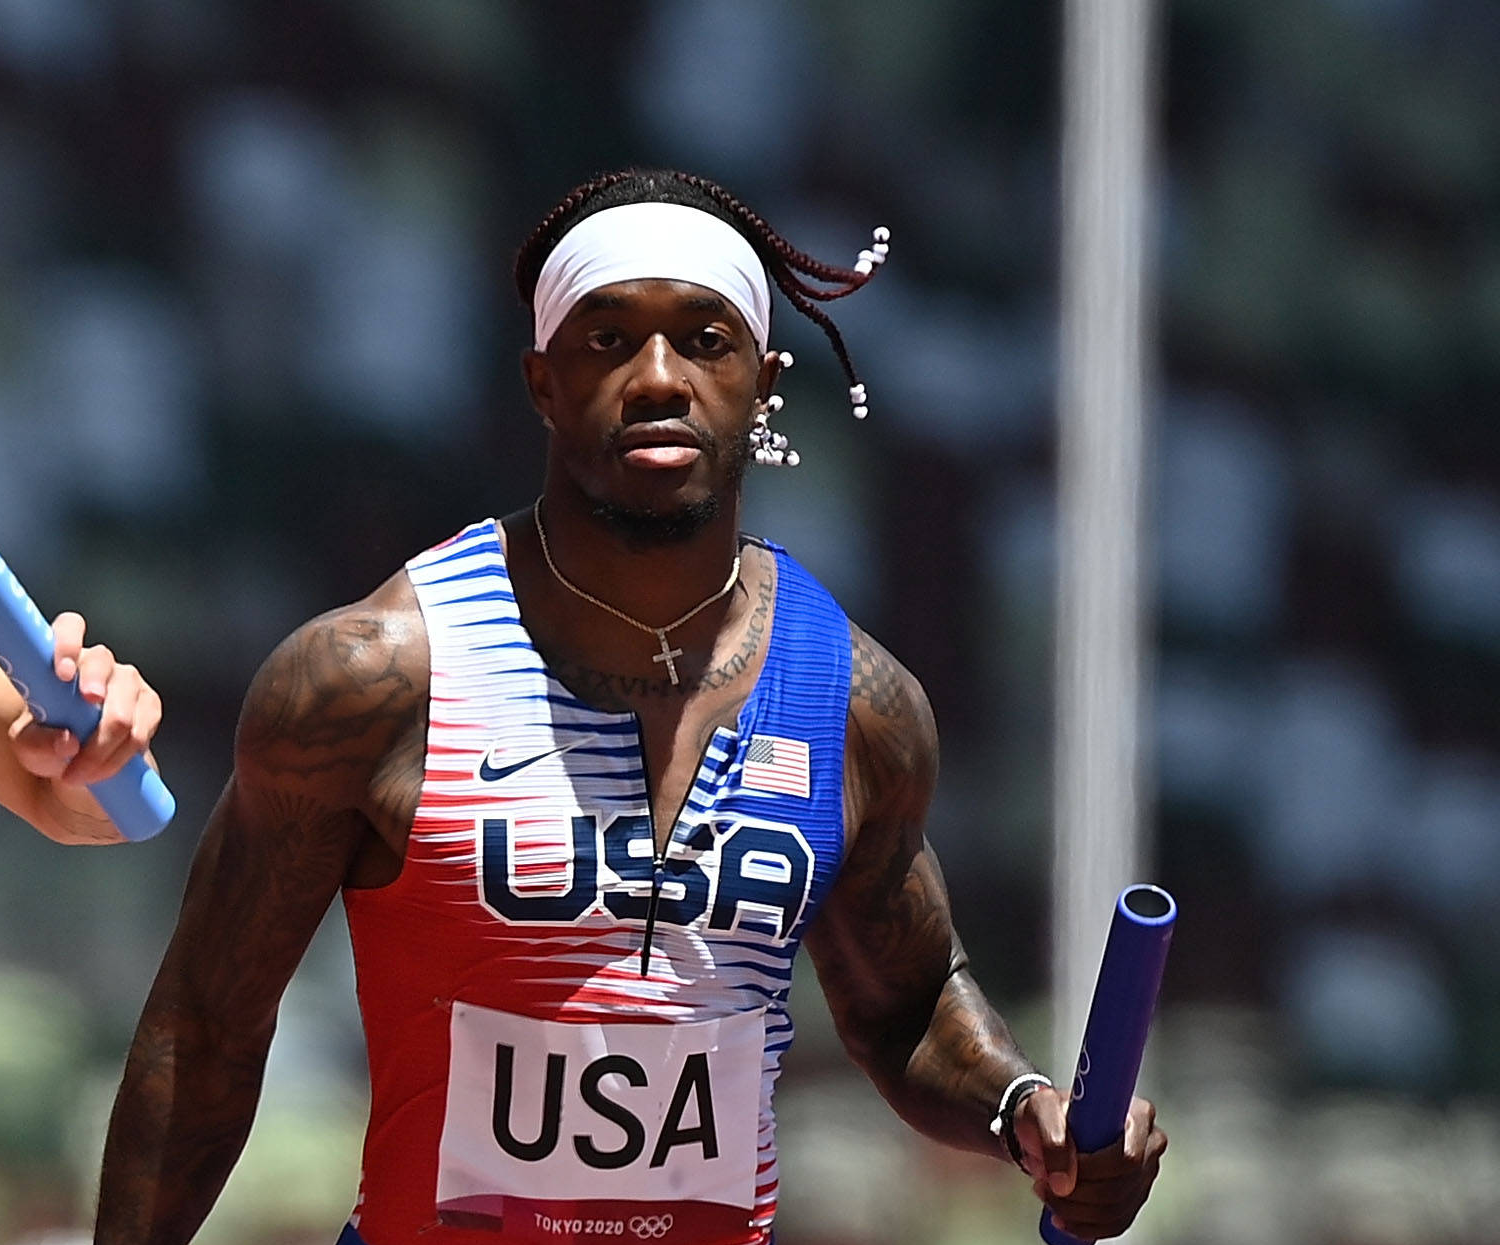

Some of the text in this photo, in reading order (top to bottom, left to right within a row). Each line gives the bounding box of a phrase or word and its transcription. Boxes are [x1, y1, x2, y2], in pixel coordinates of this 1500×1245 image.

[474, 809, 816, 946] USA
[491, 1043, 719, 1170] USA
[533, 1212, 624, 1236] TOKYO 2020
